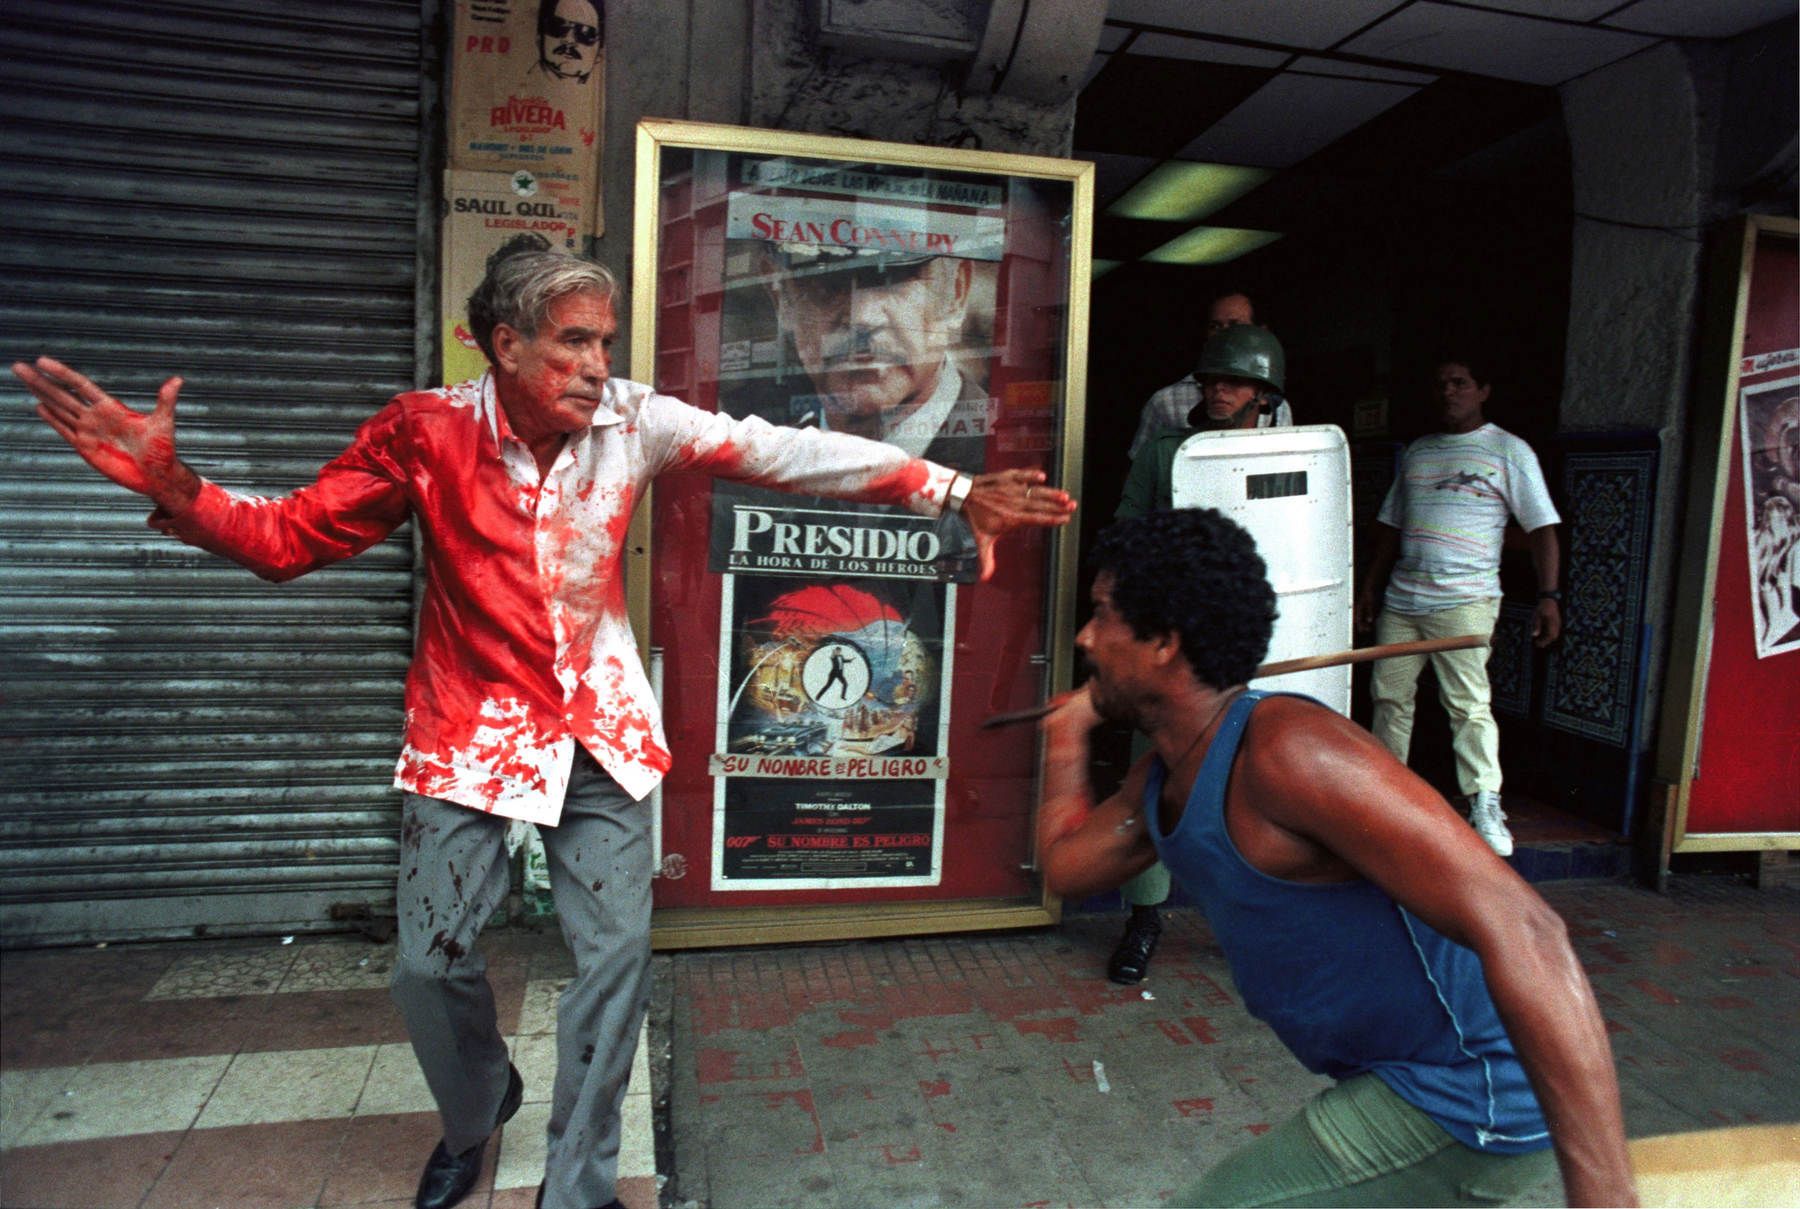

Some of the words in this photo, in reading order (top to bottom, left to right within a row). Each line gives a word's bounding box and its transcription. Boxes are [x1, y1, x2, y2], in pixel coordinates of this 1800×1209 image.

[490, 102, 566, 131] RIVERA
[454, 198, 511, 216] SAUL
[752, 212, 824, 243] SEAN
[731, 510, 941, 563] PRESIDIO
[729, 554, 749, 566] LA
[757, 557, 802, 568] HORA
[811, 559, 830, 570] DE
[839, 561, 869, 572] LOS
[876, 563, 938, 575] HEROES
[757, 758, 832, 777] NOMBRE
[791, 836, 848, 848] NOMBRE
[853, 835, 870, 848] ES
[875, 834, 931, 848] PELIGRO
